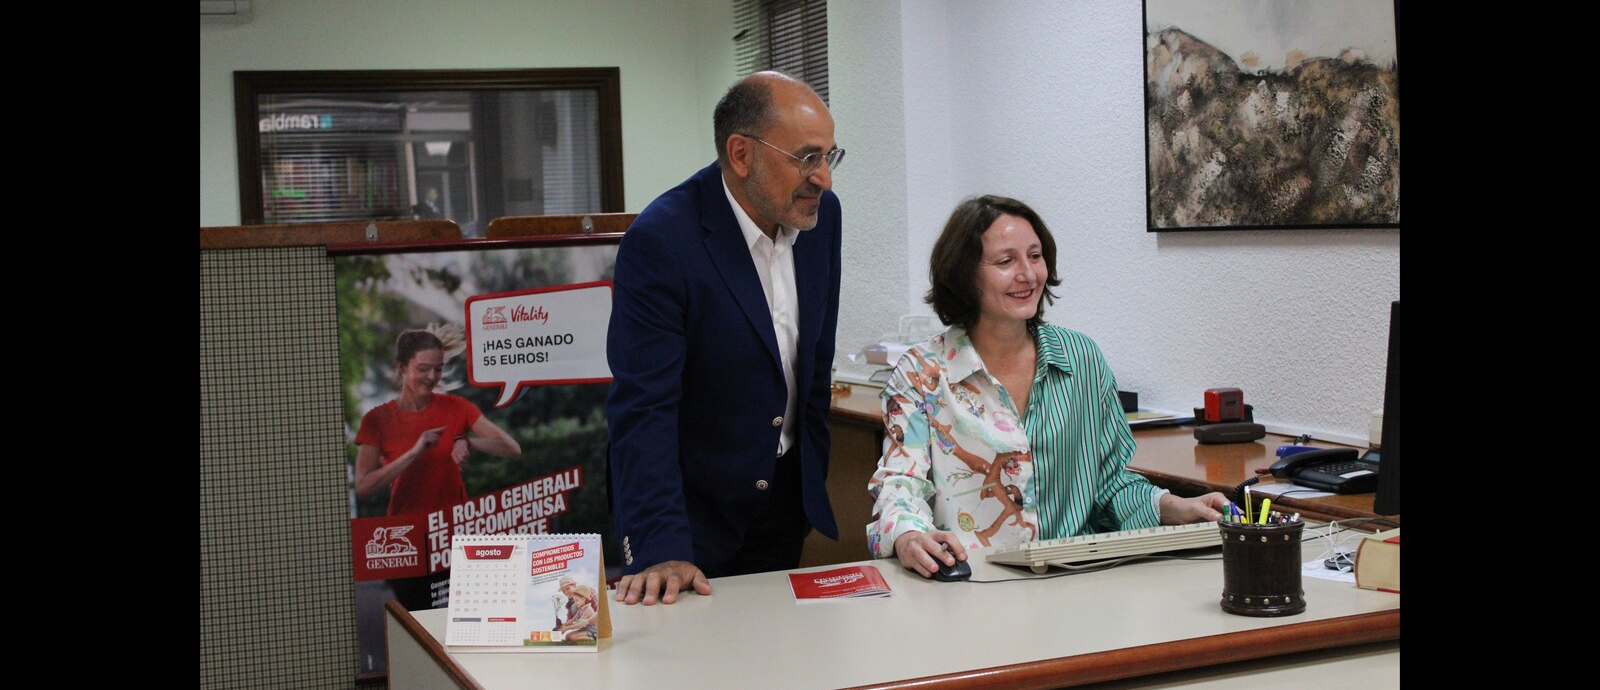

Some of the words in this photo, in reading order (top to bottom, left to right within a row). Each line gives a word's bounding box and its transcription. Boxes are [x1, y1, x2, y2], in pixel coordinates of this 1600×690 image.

[510, 304, 549, 326] Vitality
[483, 338, 512, 353] ¡HAS
[515, 333, 574, 349] GANADO
[483, 356, 497, 366] 55
[500, 352, 549, 365] EUROS!
[428, 510, 449, 533] EL
[452, 494, 497, 525] ROJO
[501, 468, 580, 510] GENERALI
[428, 529, 449, 552] TE
[453, 493, 566, 536] RECOMPENSA
[430, 548, 451, 572] PO
[475, 549, 502, 558] agosto
[532, 544, 575, 559] COMPROMETIDOS
[554, 550, 583, 563] PRODUCTOS
[366, 556, 418, 570] GENERALI
